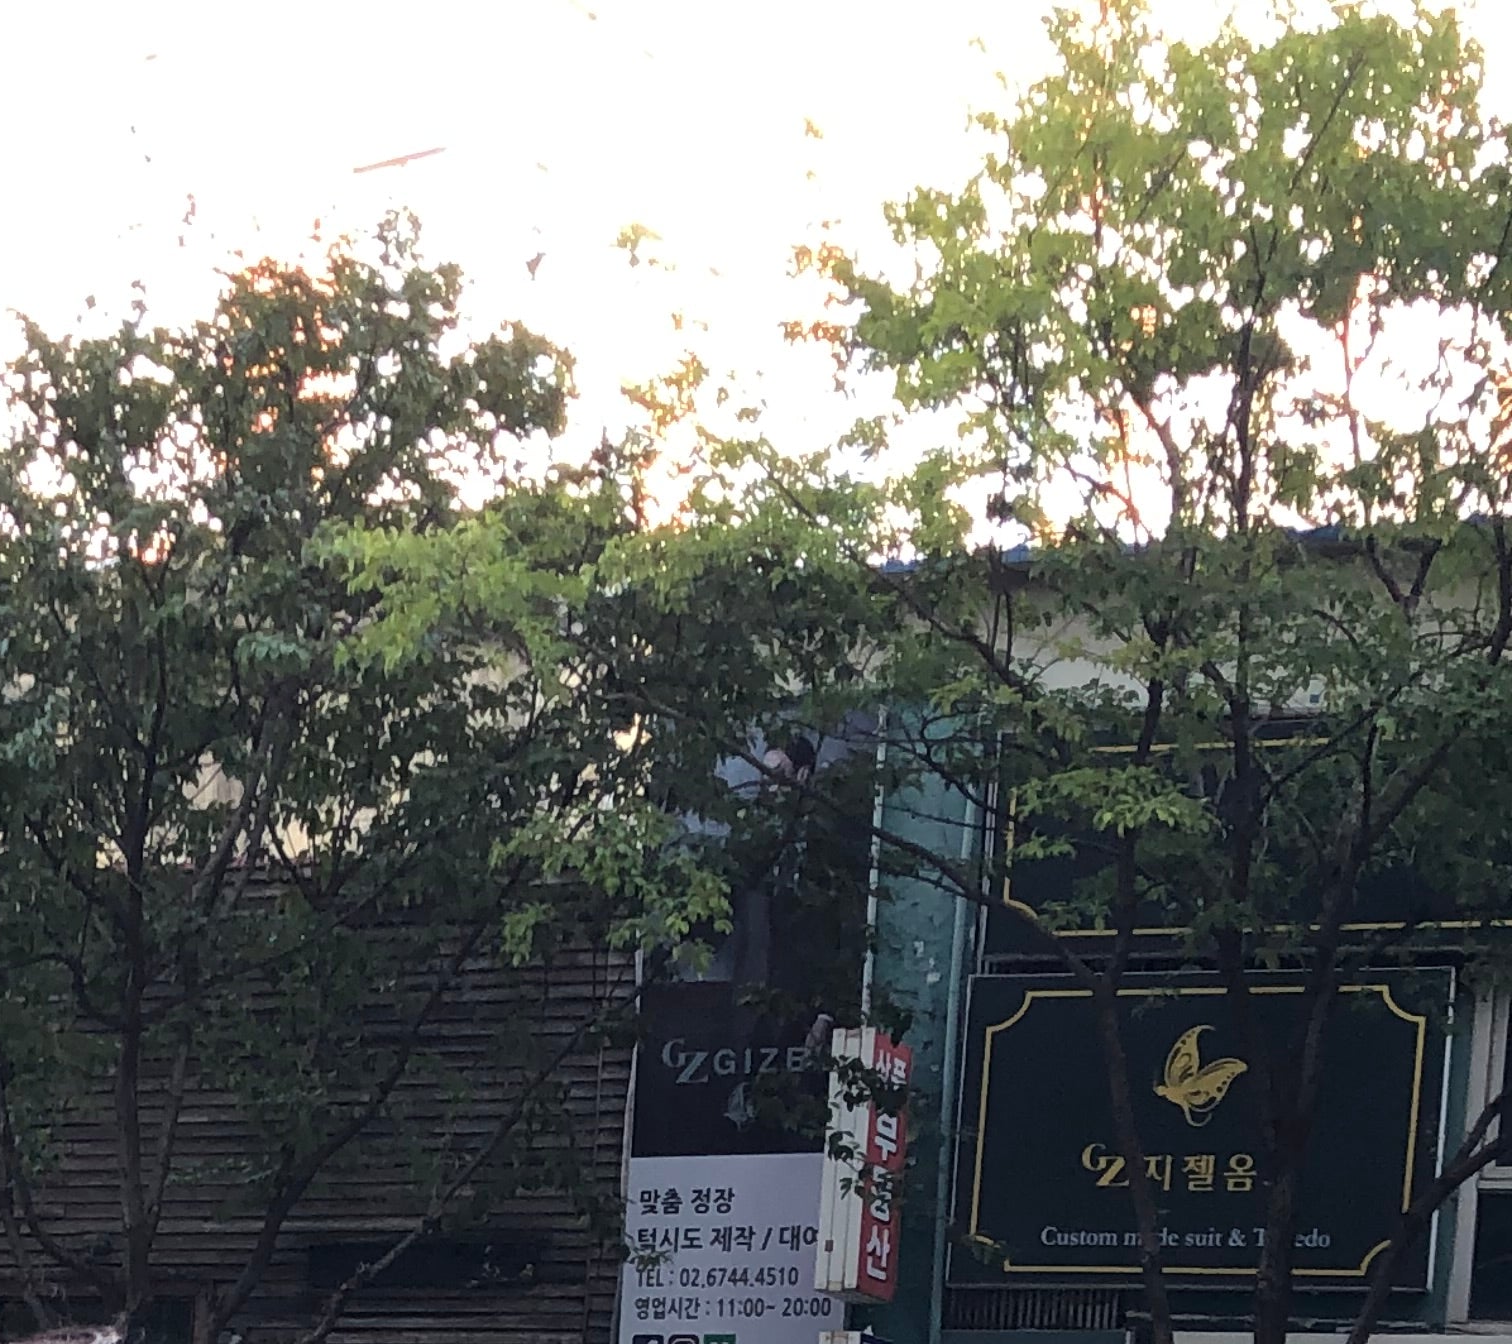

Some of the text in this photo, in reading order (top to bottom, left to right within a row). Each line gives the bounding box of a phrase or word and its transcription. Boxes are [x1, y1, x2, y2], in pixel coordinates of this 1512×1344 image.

[713, 1047, 810, 1075] GIZE
[1144, 1153, 1272, 1192] 지젤옴
[640, 1187, 735, 1215] 맞춤 정장
[637, 1226, 703, 1252] 턱시도
[709, 1225, 756, 1251] 제작
[1040, 1225, 1331, 1249] Custom mde suit & Tedo
[635, 1297, 700, 1320] 영업시간
[782, 1298, 831, 1317] 20:00
